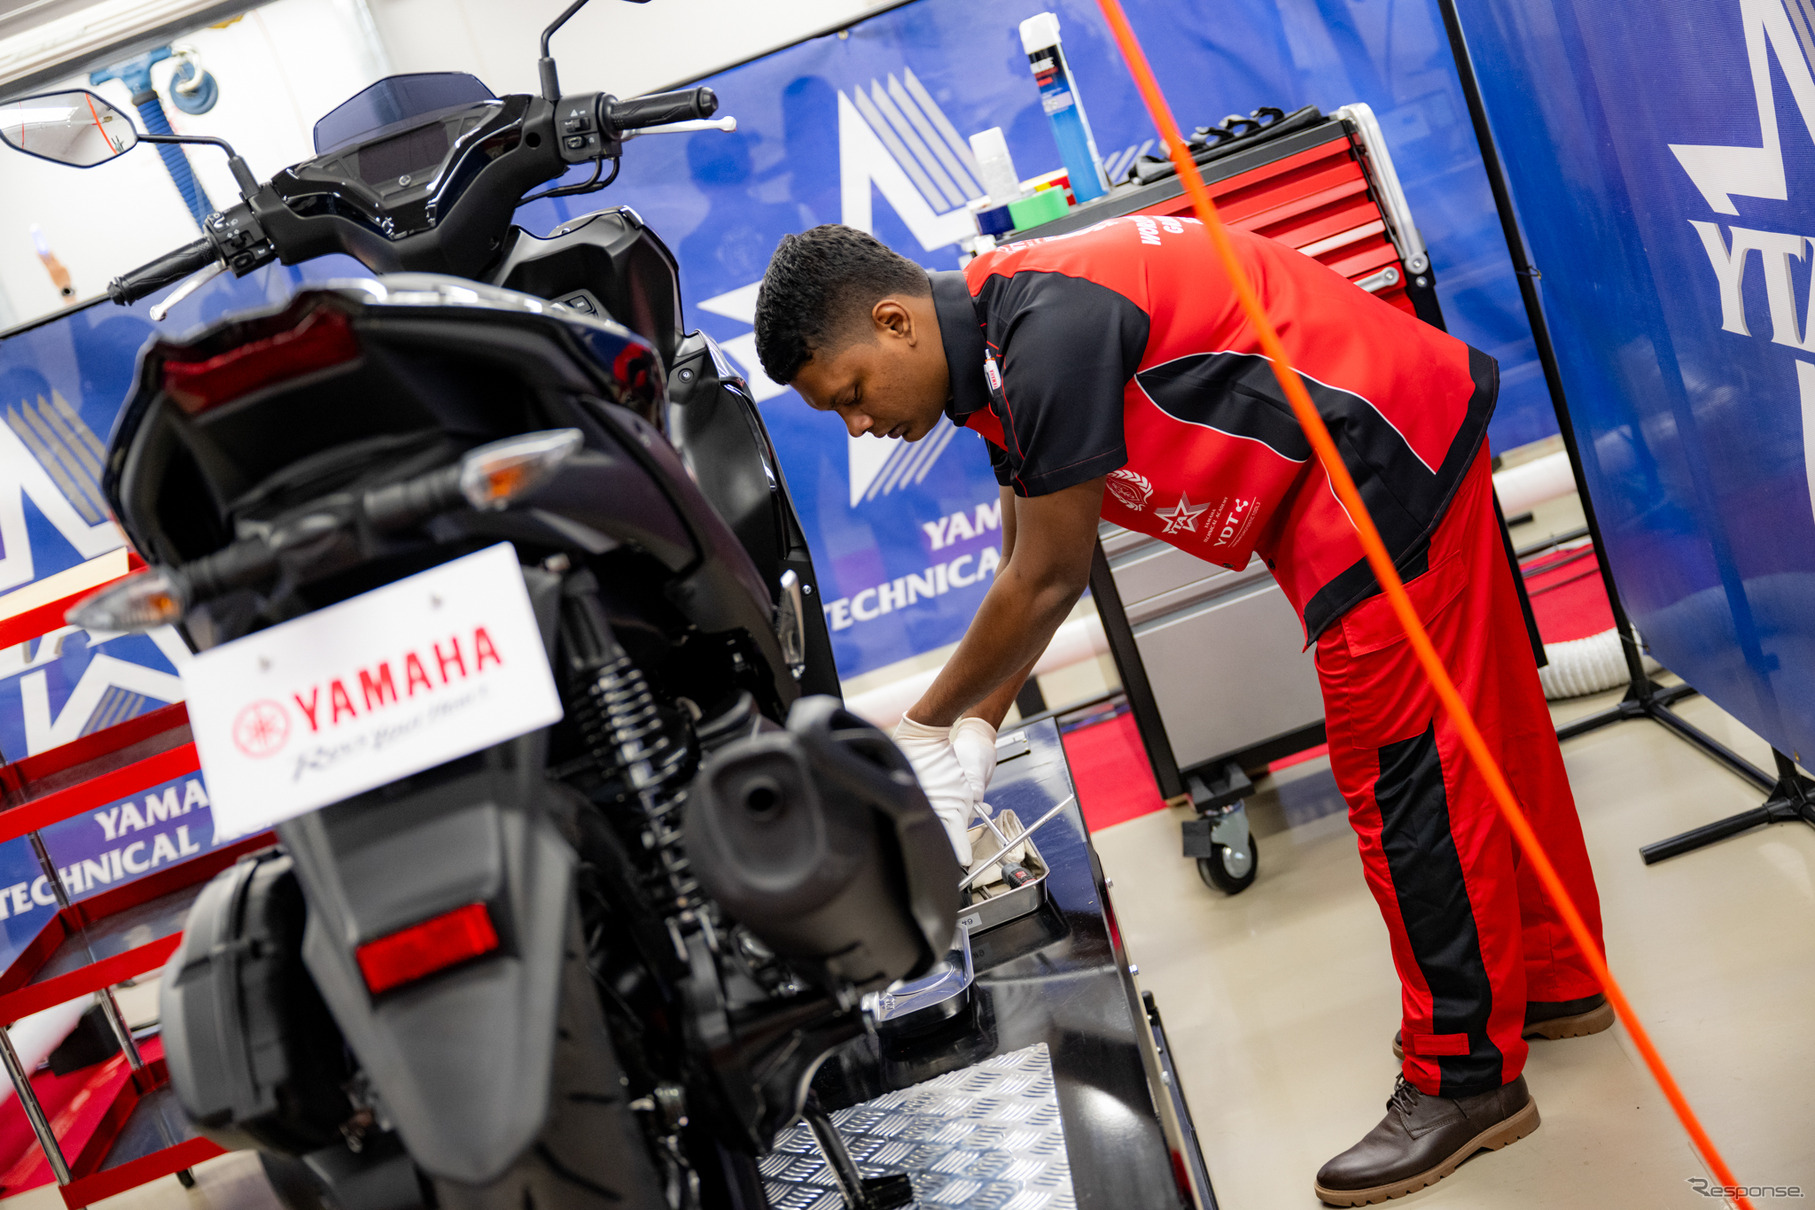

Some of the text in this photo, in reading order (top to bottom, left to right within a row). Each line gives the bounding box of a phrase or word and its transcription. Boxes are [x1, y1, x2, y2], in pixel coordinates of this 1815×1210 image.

[1687, 219, 1815, 353] YT
[922, 497, 1001, 551] YAM
[823, 546, 1001, 632] ECHNICA
[293, 625, 502, 733] YAMAHA
[94, 778, 209, 842] YAMA
[0, 824, 200, 921] TECHNICAL
